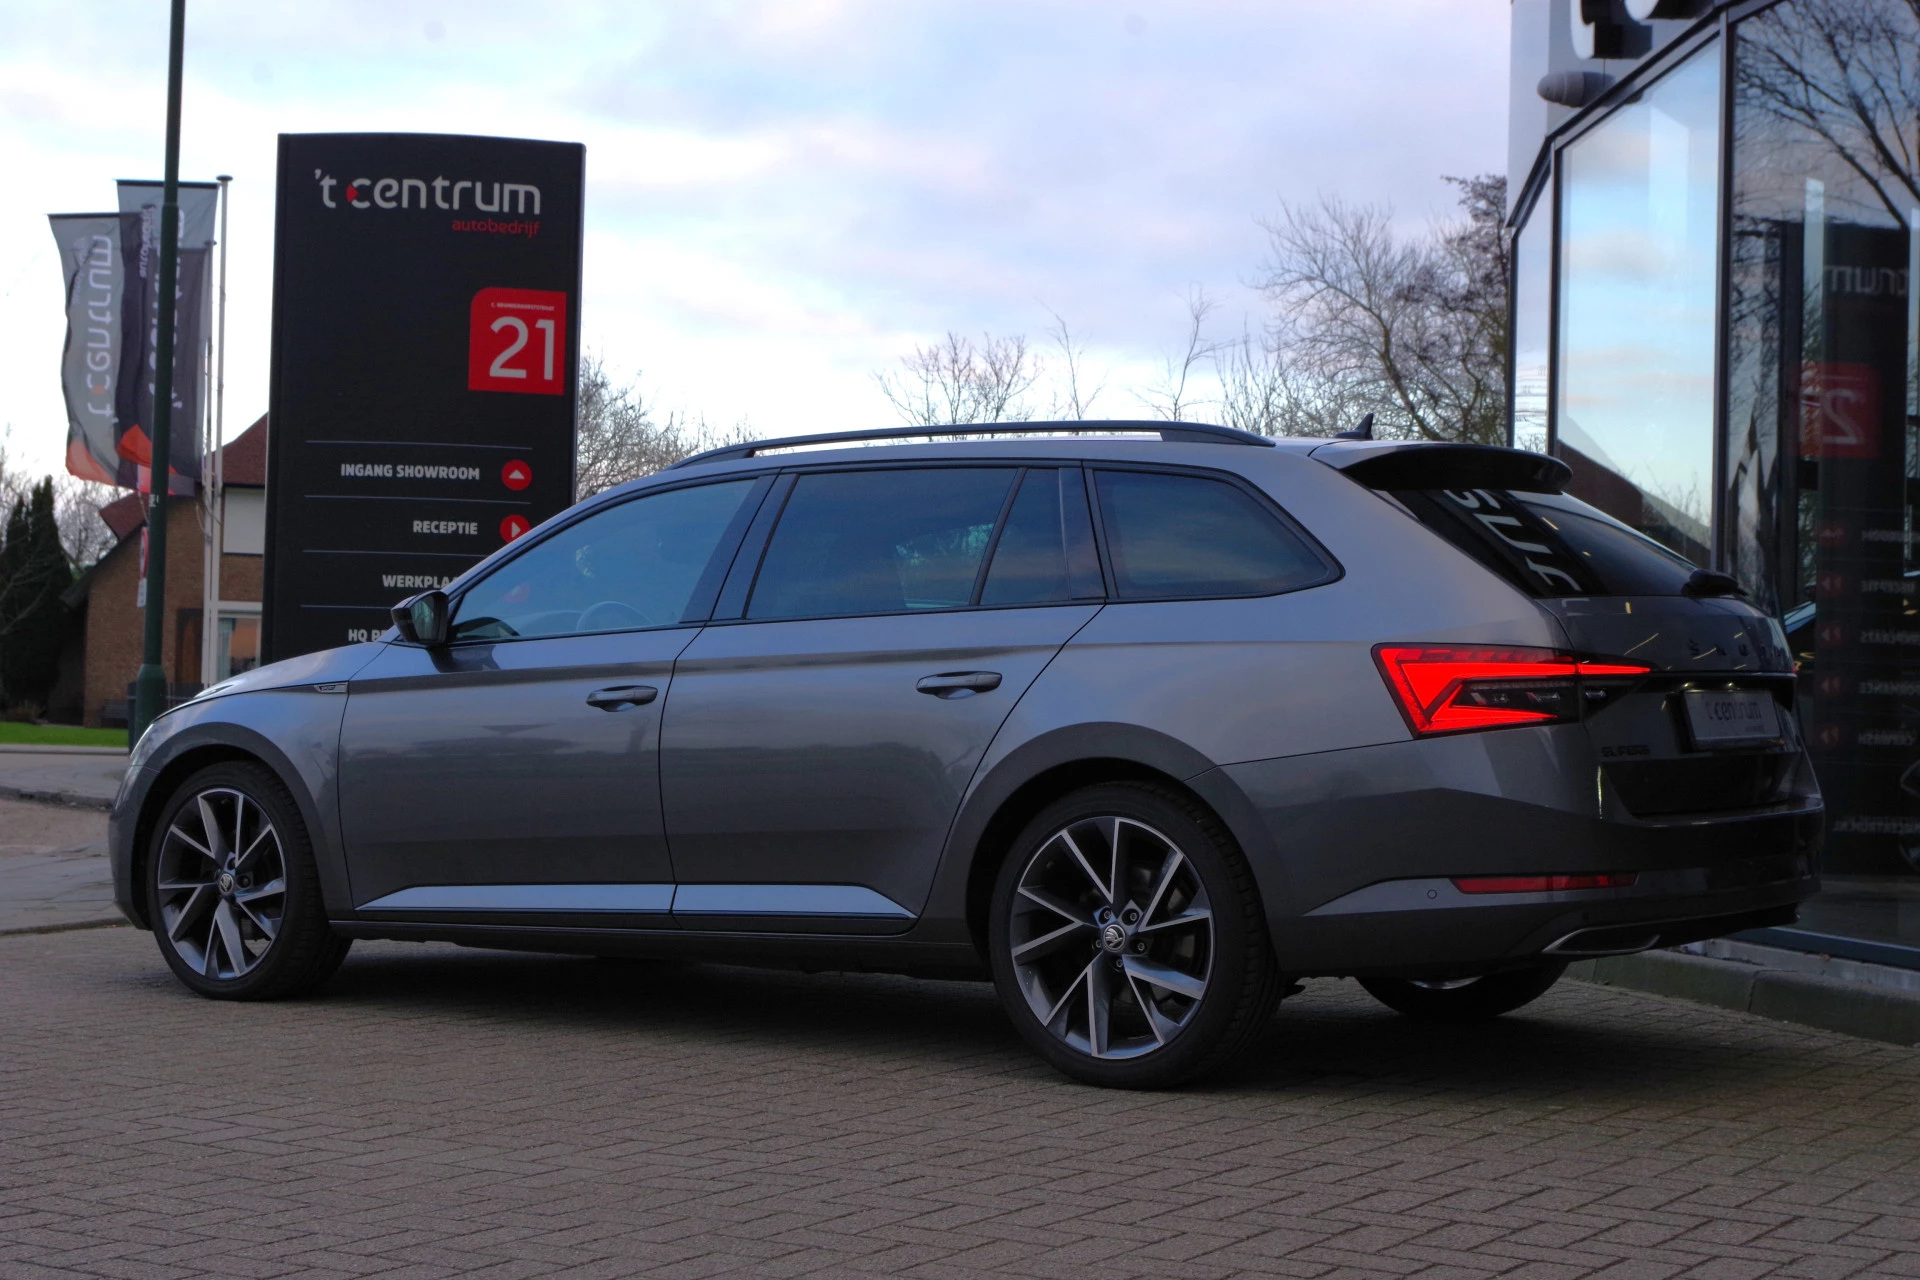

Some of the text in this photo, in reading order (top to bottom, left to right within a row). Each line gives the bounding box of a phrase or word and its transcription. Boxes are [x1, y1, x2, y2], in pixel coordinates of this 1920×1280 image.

[350, 175, 541, 215] centrum
[452, 218, 541, 239] autobedrijf
[489, 315, 555, 381] 21
[340, 463, 480, 481] INGANG SHOWROOM
[412, 519, 478, 535] RECEPTIE
[348, 628, 368, 642] HQ
